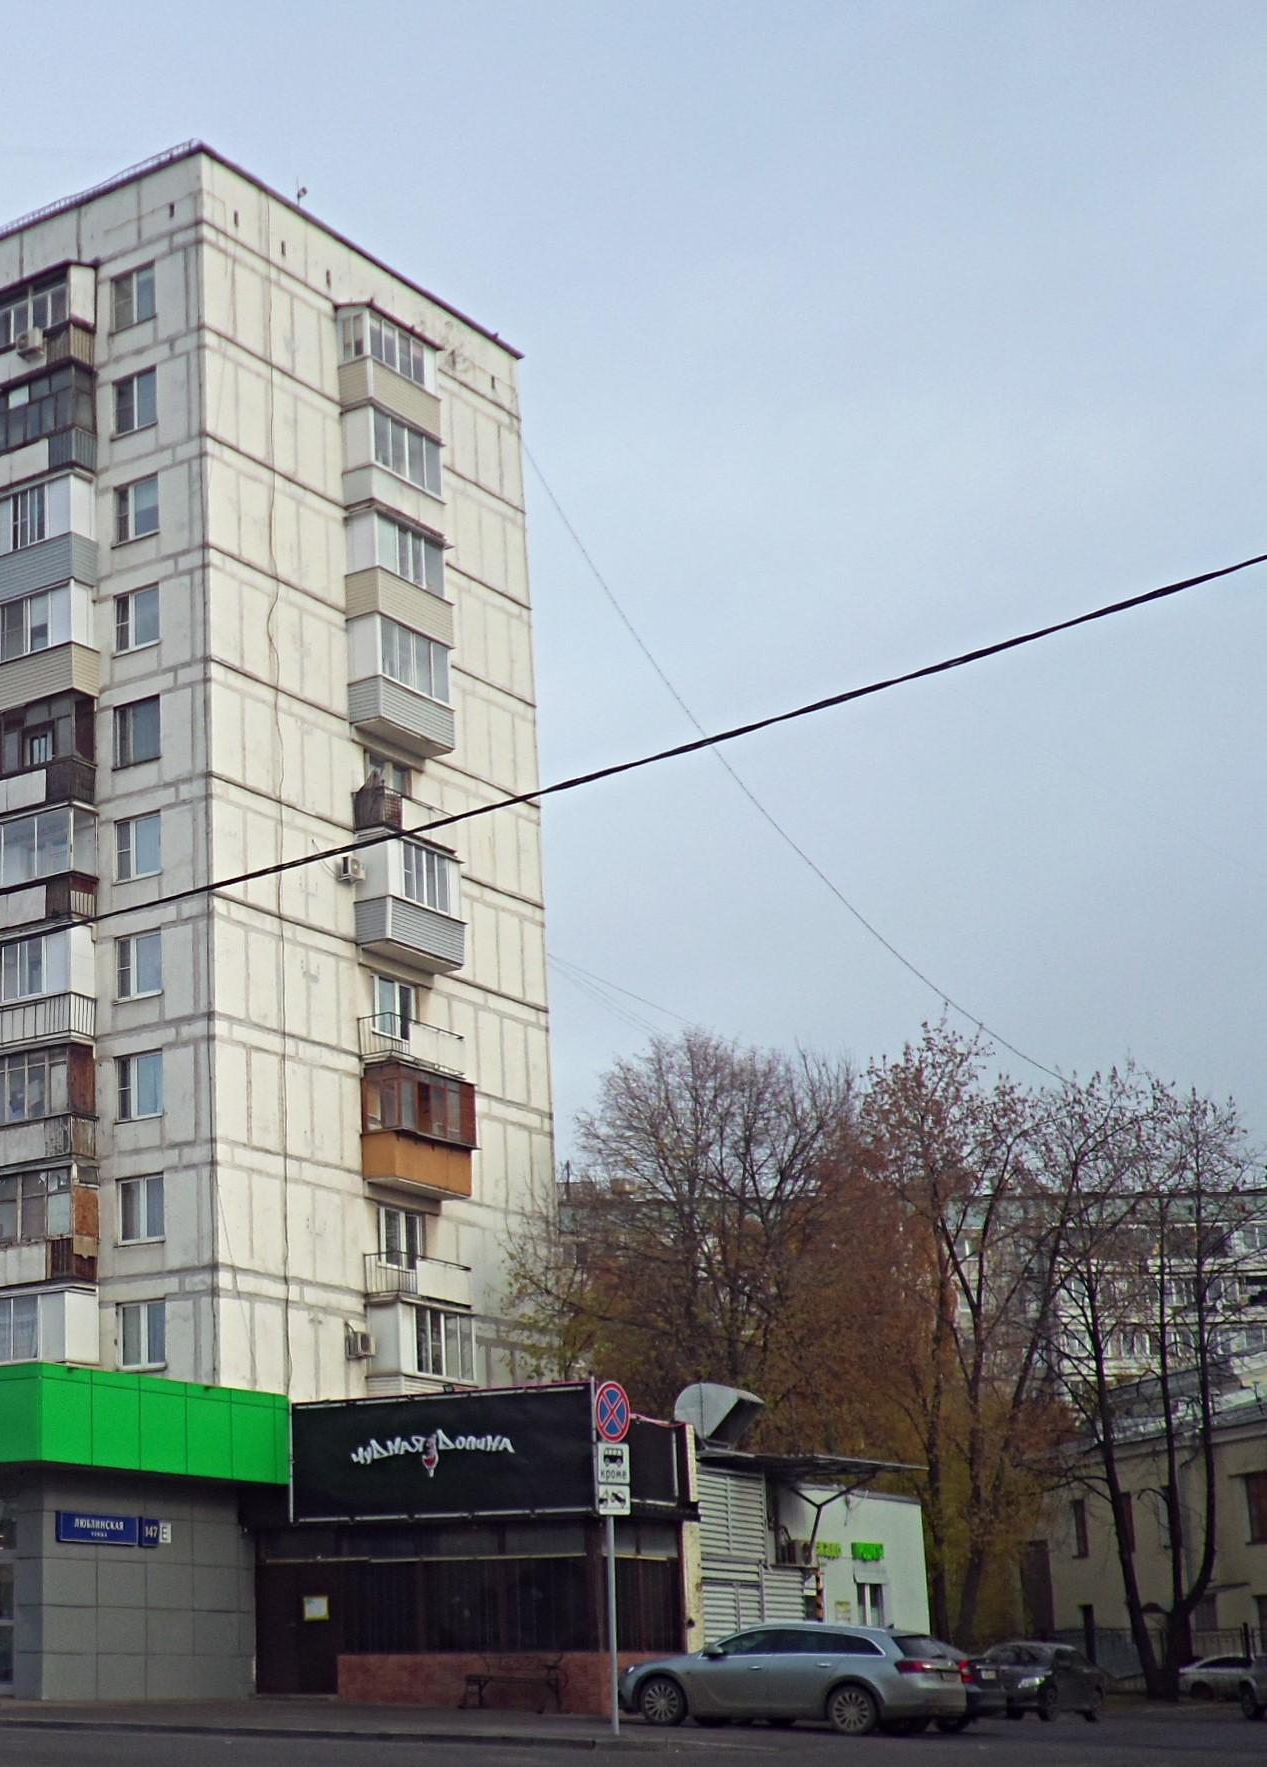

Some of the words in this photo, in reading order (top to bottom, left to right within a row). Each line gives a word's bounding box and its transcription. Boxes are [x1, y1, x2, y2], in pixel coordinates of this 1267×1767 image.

[600, 1470, 627, 1482] кроме
[74, 1518, 124, 1531] ЛЮБЛИНСКАЯ
[145, 1525, 159, 1538] 147
